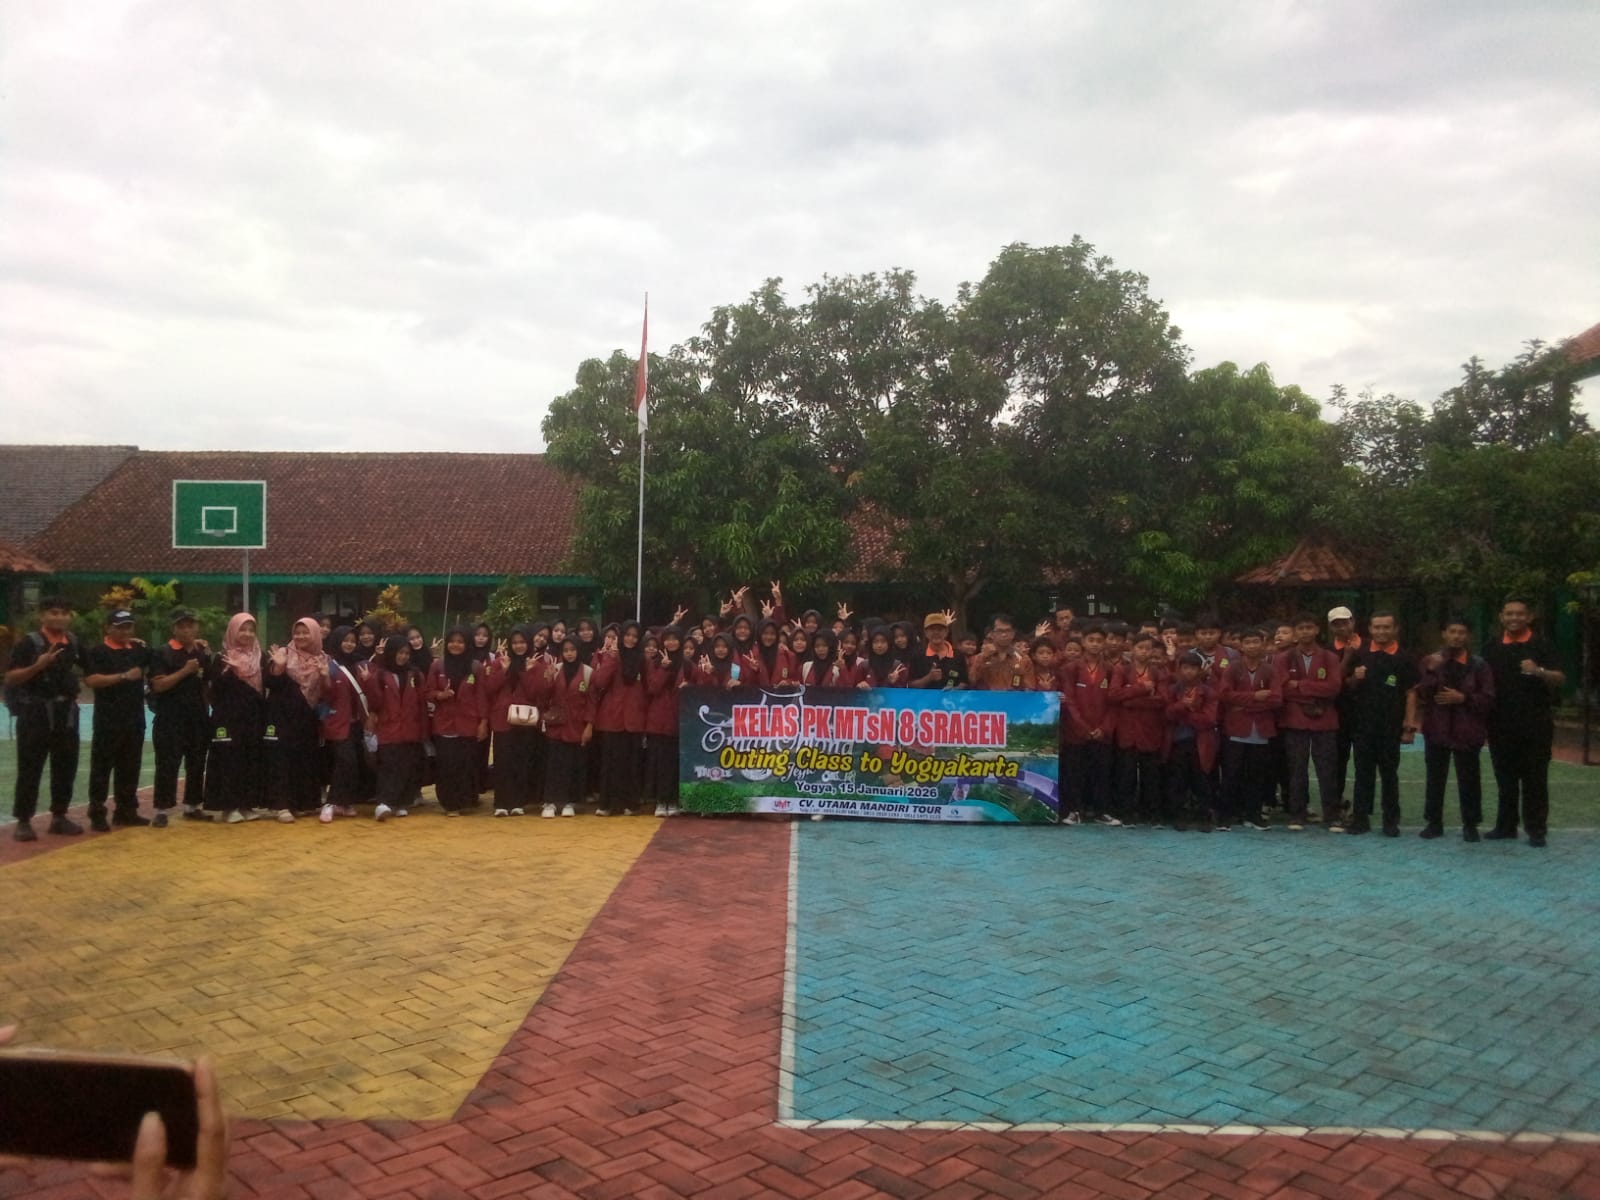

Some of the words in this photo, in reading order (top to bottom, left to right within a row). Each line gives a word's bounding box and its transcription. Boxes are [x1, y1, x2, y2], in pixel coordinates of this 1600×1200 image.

[732, 706, 798, 738] KELAS
[803, 707, 831, 739] PK
[834, 708, 894, 742] MTsN
[900, 711, 915, 744] 8
[919, 712, 1006, 746] SRAGEN
[720, 747, 790, 776] Outing
[796, 748, 853, 772] Class
[860, 752, 882, 773] to
[890, 752, 1019, 783] Yogyakarta
[796, 781, 835, 795] Yogya,
[840, 783, 854, 794] 15
[858, 785, 903, 797] Januari
[907, 787, 938, 798] 2026
[799, 799, 815, 808] CV.
[818, 800, 857, 809] UTAMA
[860, 802, 909, 812] MANDIRI
[912, 805, 942, 814] TOUR
